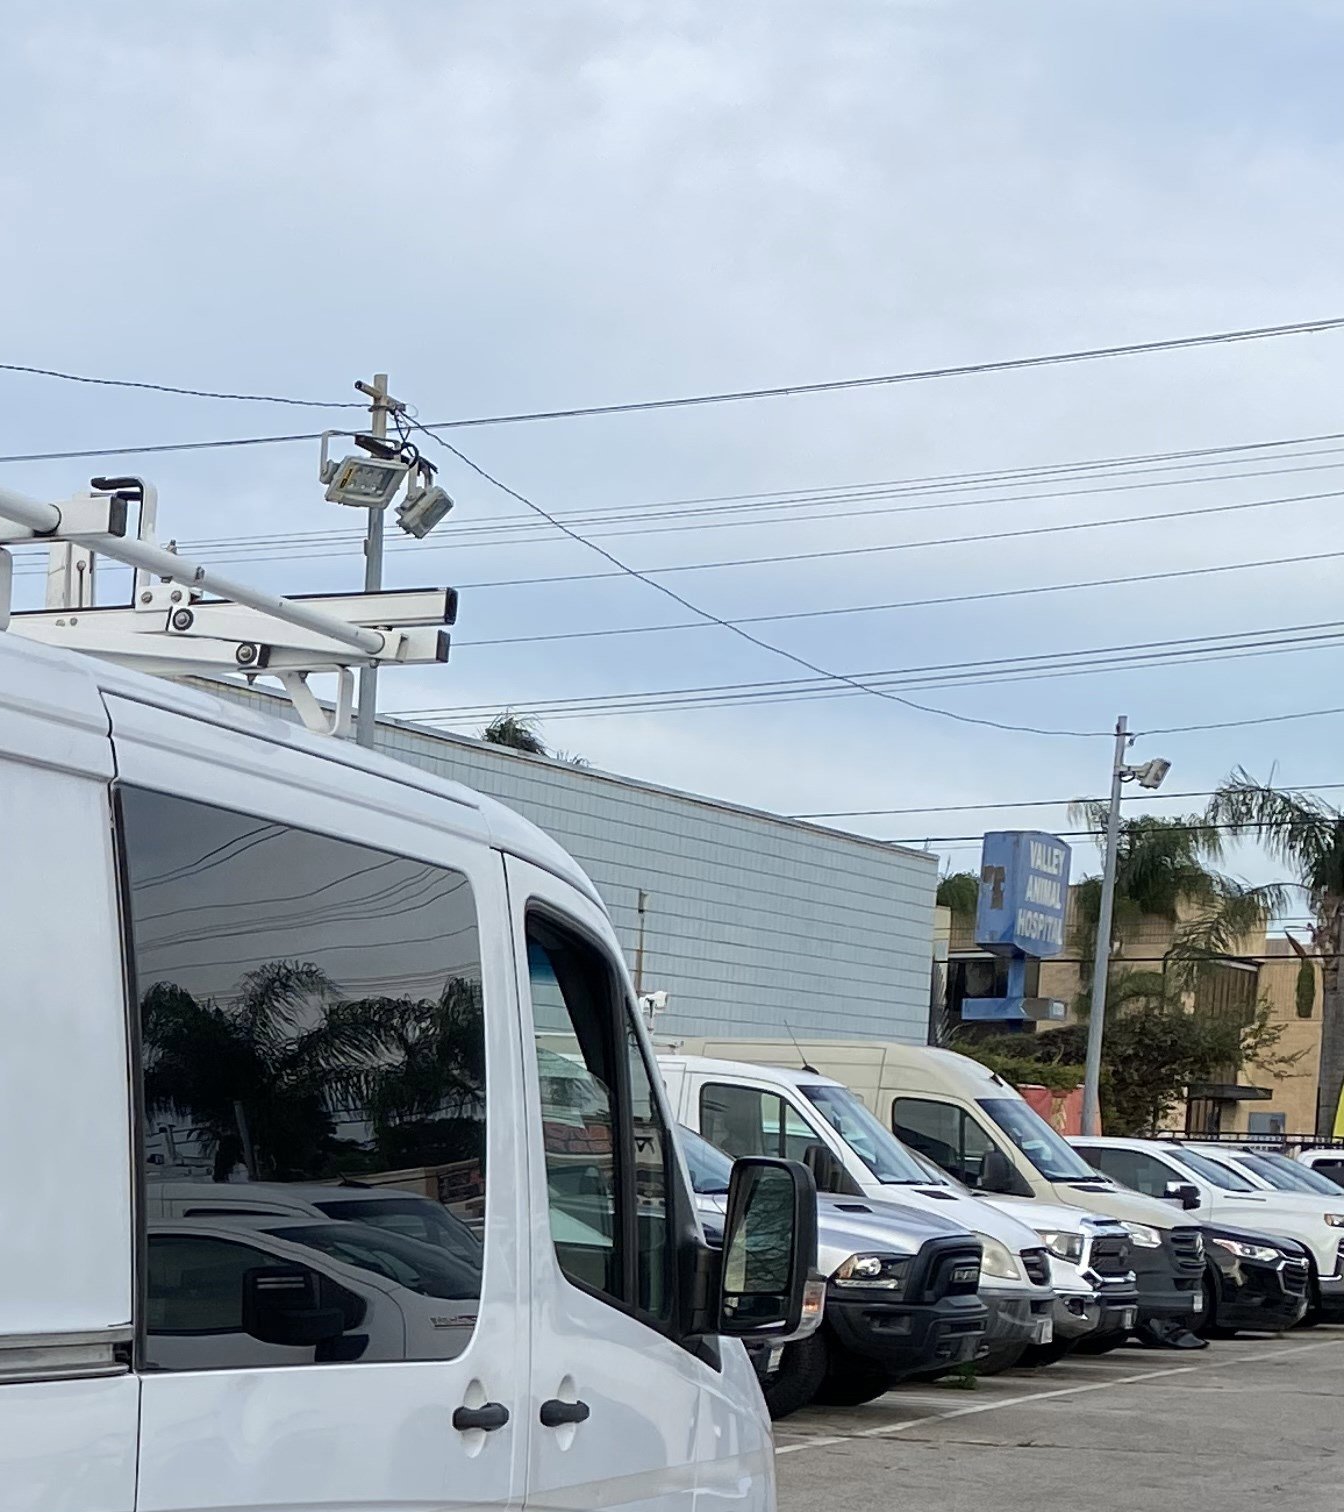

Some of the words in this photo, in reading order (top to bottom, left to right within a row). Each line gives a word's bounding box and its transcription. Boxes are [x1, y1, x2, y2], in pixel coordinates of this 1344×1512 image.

[1029, 839, 1066, 877] VALLEY
[1024, 874, 1062, 910] ANIMAL
[1015, 907, 1063, 946] HOSPITAL
